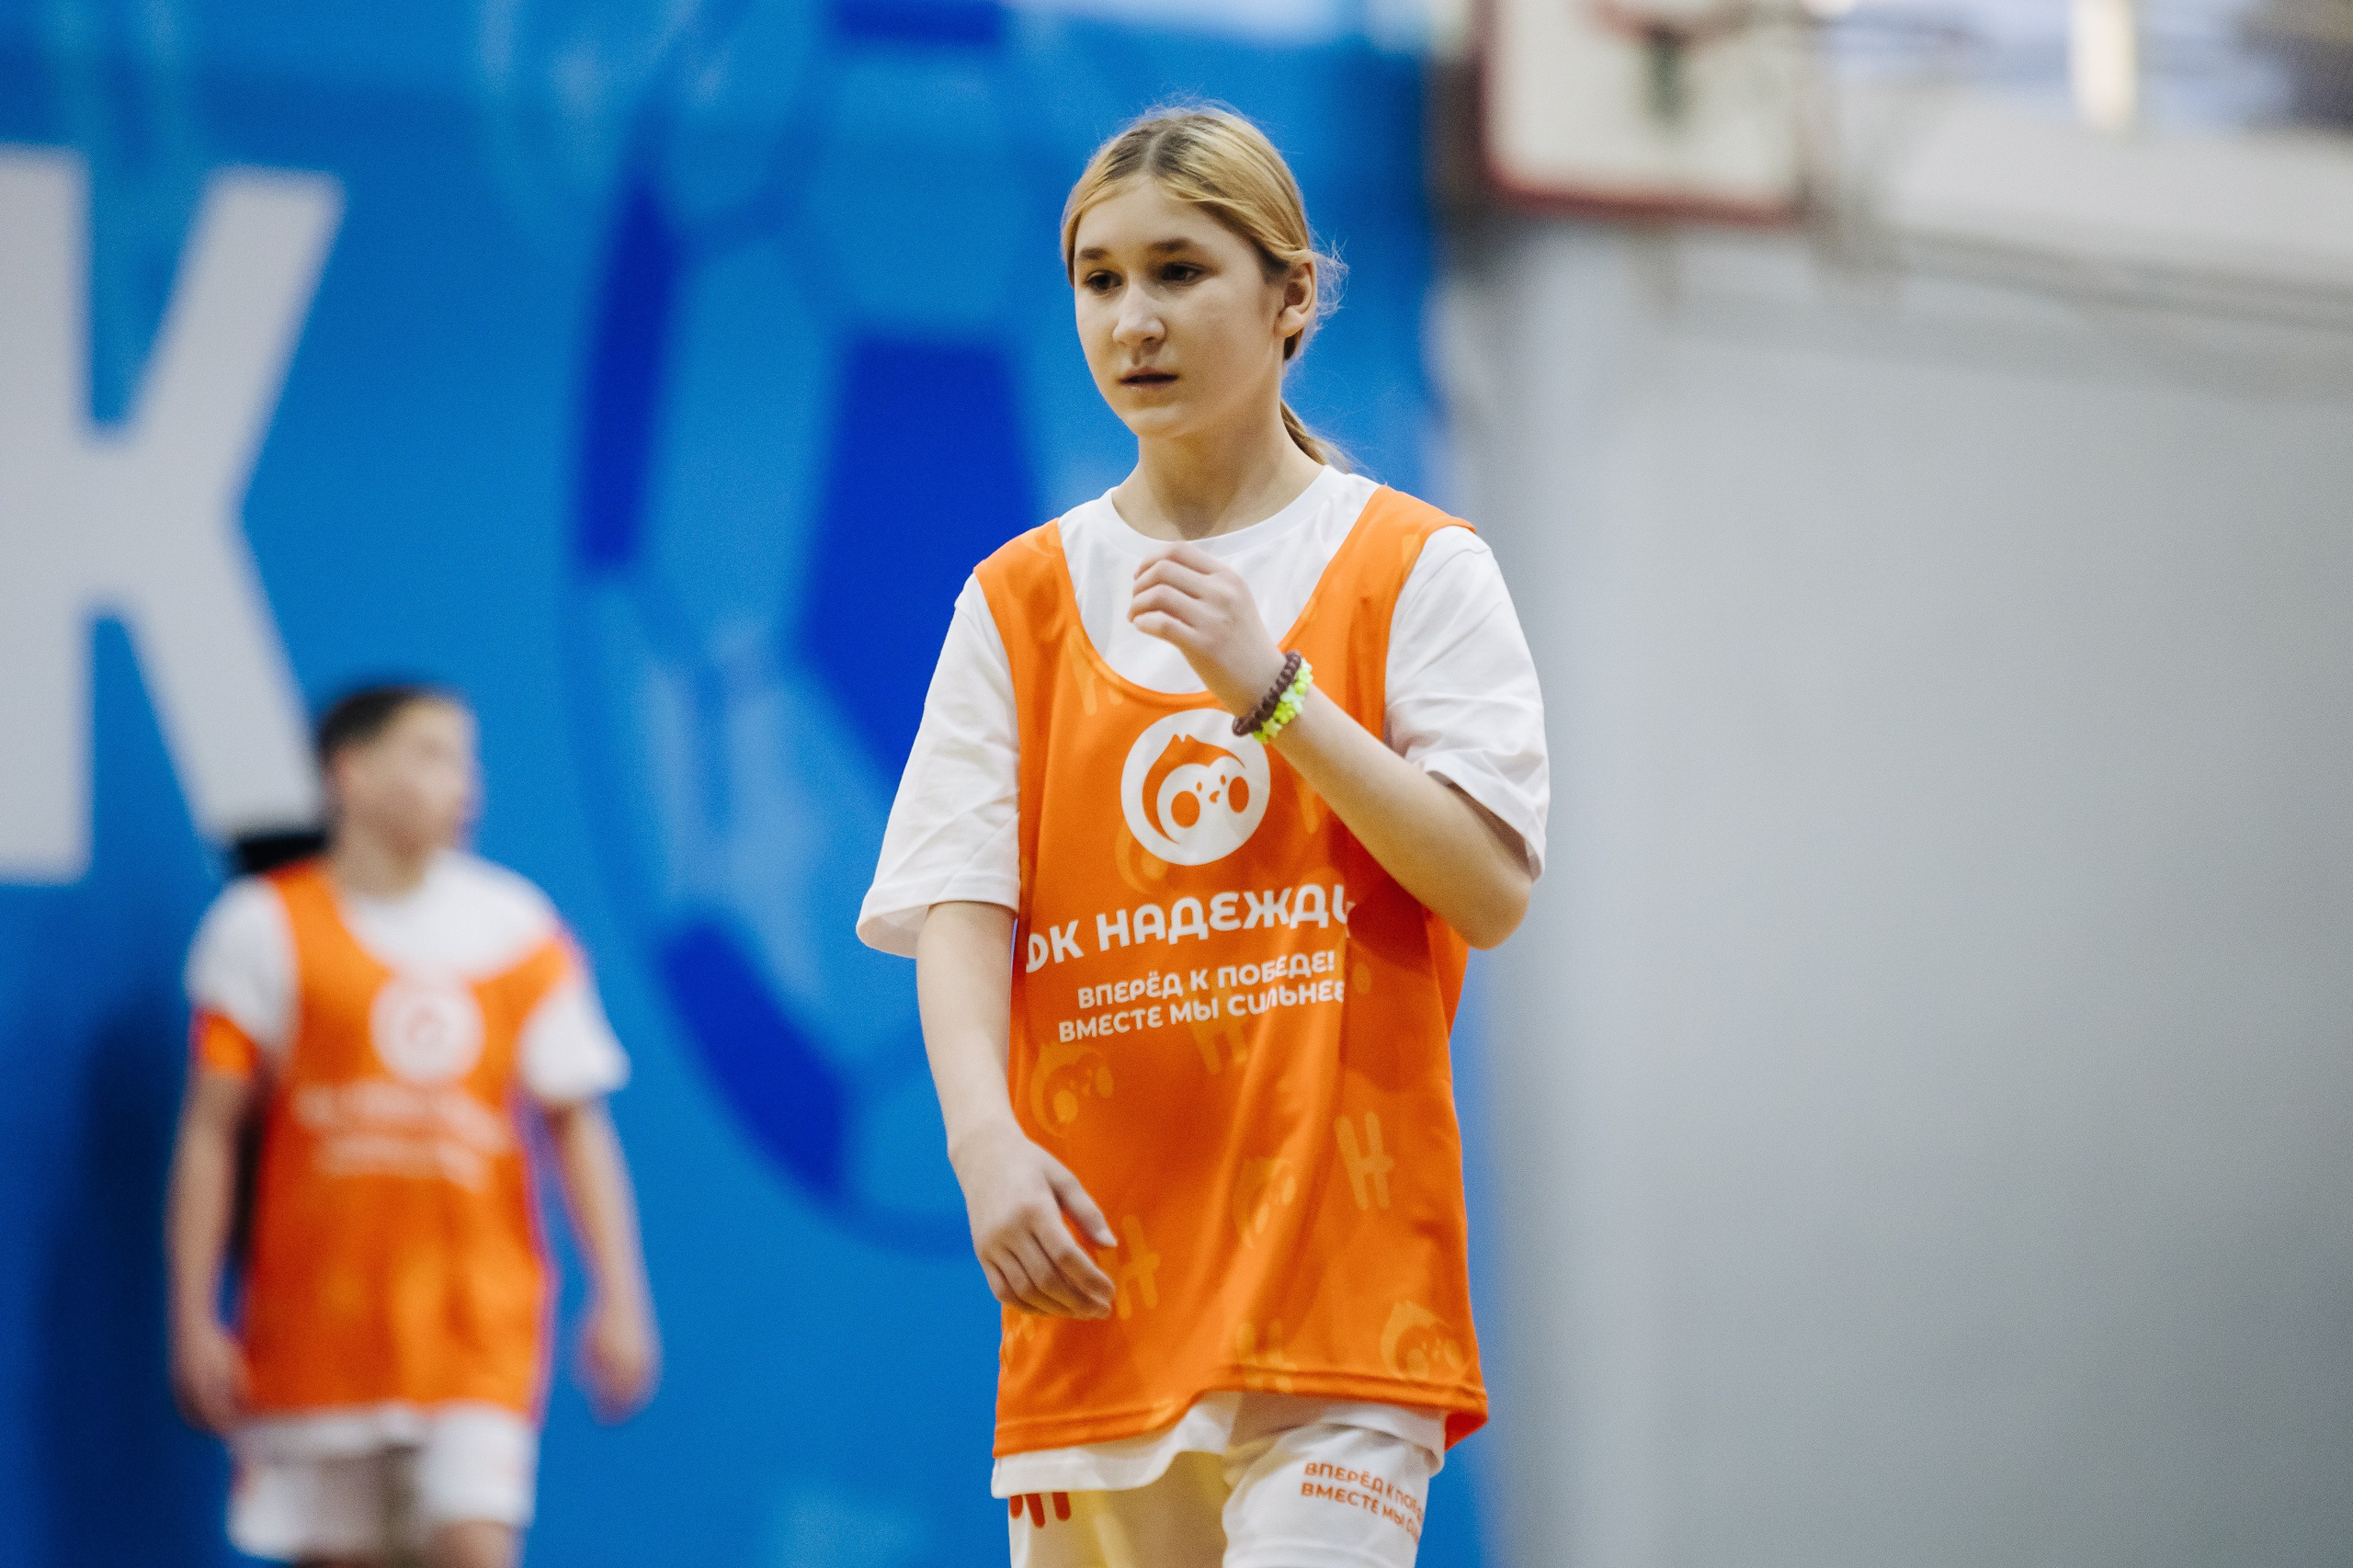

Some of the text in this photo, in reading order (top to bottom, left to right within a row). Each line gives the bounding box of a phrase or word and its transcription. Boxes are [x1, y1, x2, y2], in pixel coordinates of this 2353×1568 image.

[1077, 950, 1336, 1009] ВПЕРЁД К ПОБЕДЕ!
[1058, 1005, 1165, 1043] ВМЕСТЕ
[1169, 996, 1220, 1026] МЫ
[1300, 1481, 1380, 1516] ВМЕСТЕ
[1304, 1461, 1384, 1495] ВПЕРЁД
